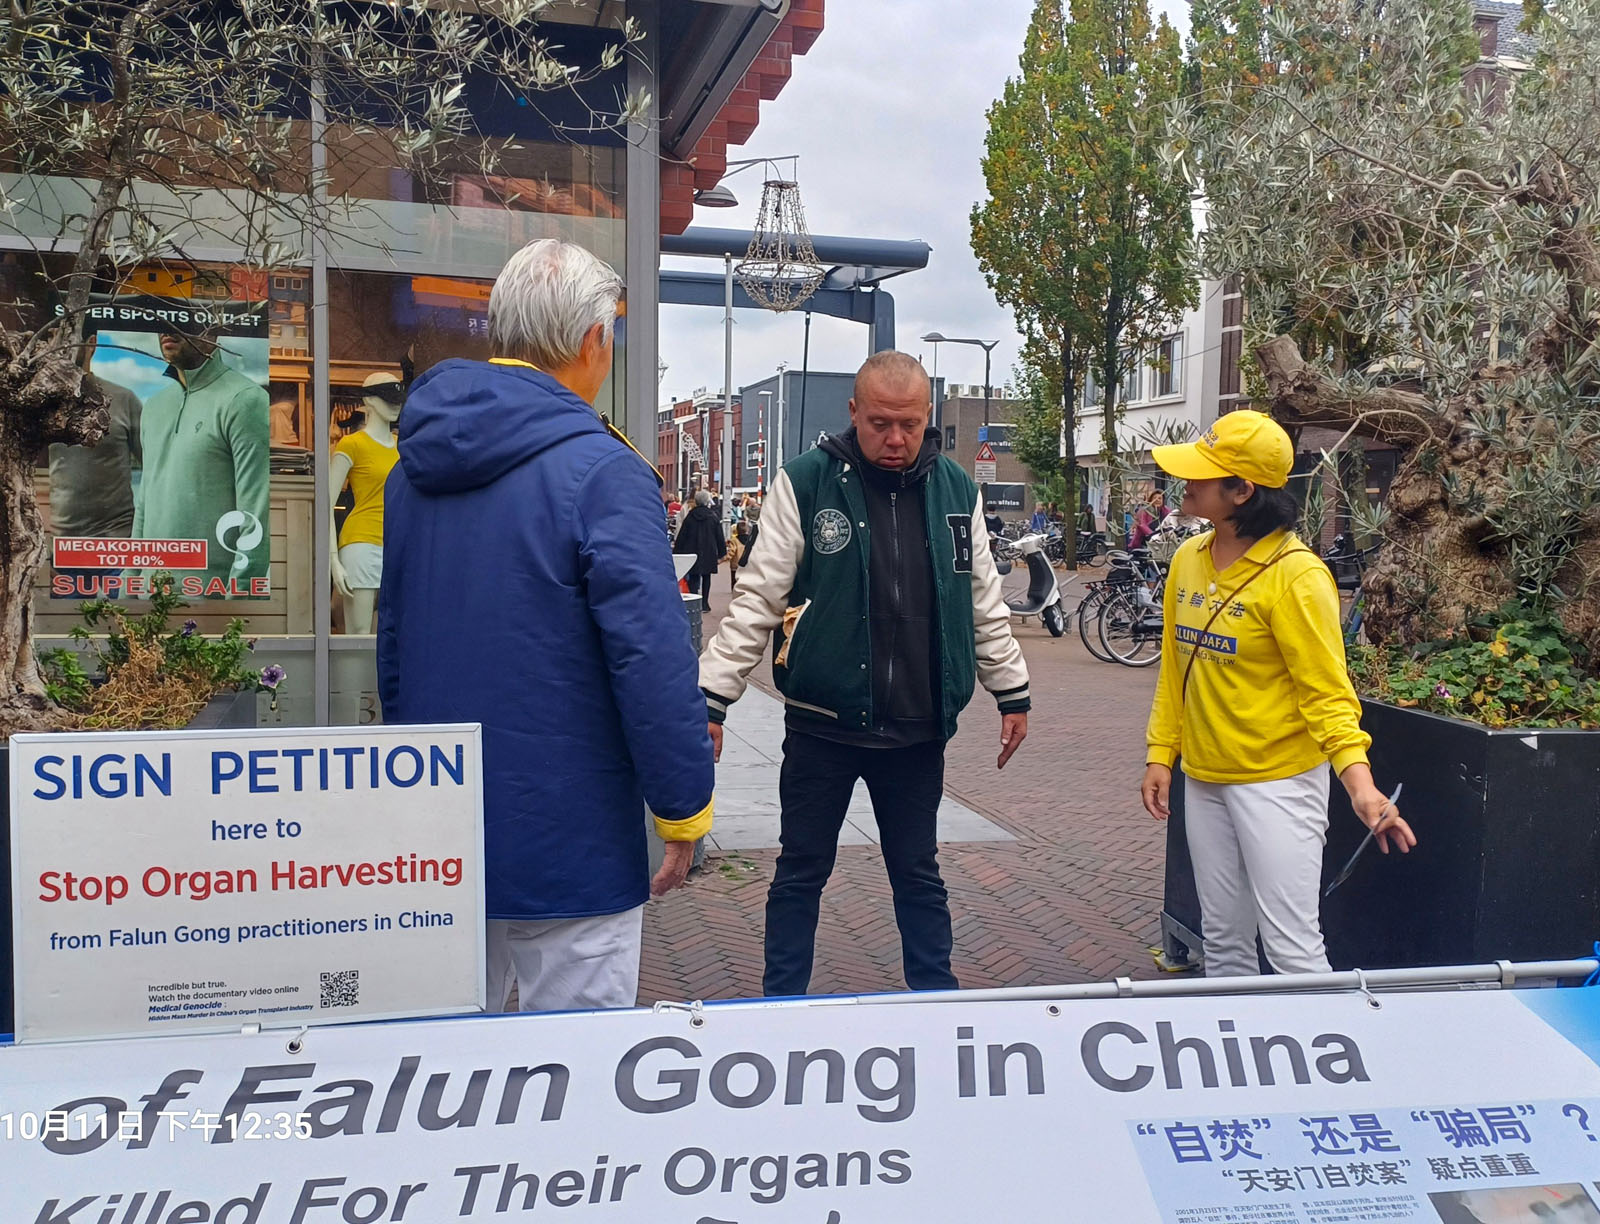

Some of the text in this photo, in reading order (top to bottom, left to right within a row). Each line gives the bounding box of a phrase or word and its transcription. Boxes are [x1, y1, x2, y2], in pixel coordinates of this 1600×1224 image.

[119, 309, 189, 323] SPORTS
[58, 540, 202, 553] MEGAKORTINGEN
[98, 554, 165, 567] TOT 80%
[182, 577, 270, 597] SALE
[1201, 634, 1231, 651] DAFA
[33, 744, 464, 800] SIGN PETITION
[211, 817, 302, 841] here to
[38, 854, 463, 905] Stop Organ Harvesting
[49, 911, 454, 950] from Falun Gong practitioners in China
[148, 983, 189, 992] Incredible
[148, 985, 299, 1003] Watch the documentary video online
[148, 1001, 223, 1013] Medical Genocide
[148, 1014, 171, 1022] Hidden
[187, 1011, 208, 1019] Murder
[239, 1007, 257, 1015] Organ
[258, 1005, 289, 1014] Transplant
[290, 1003, 314, 1012] Industry
[41, 1020, 1372, 1156] of Falun Gong in China
[30, 1147, 913, 1224] Killed For Their Organs
